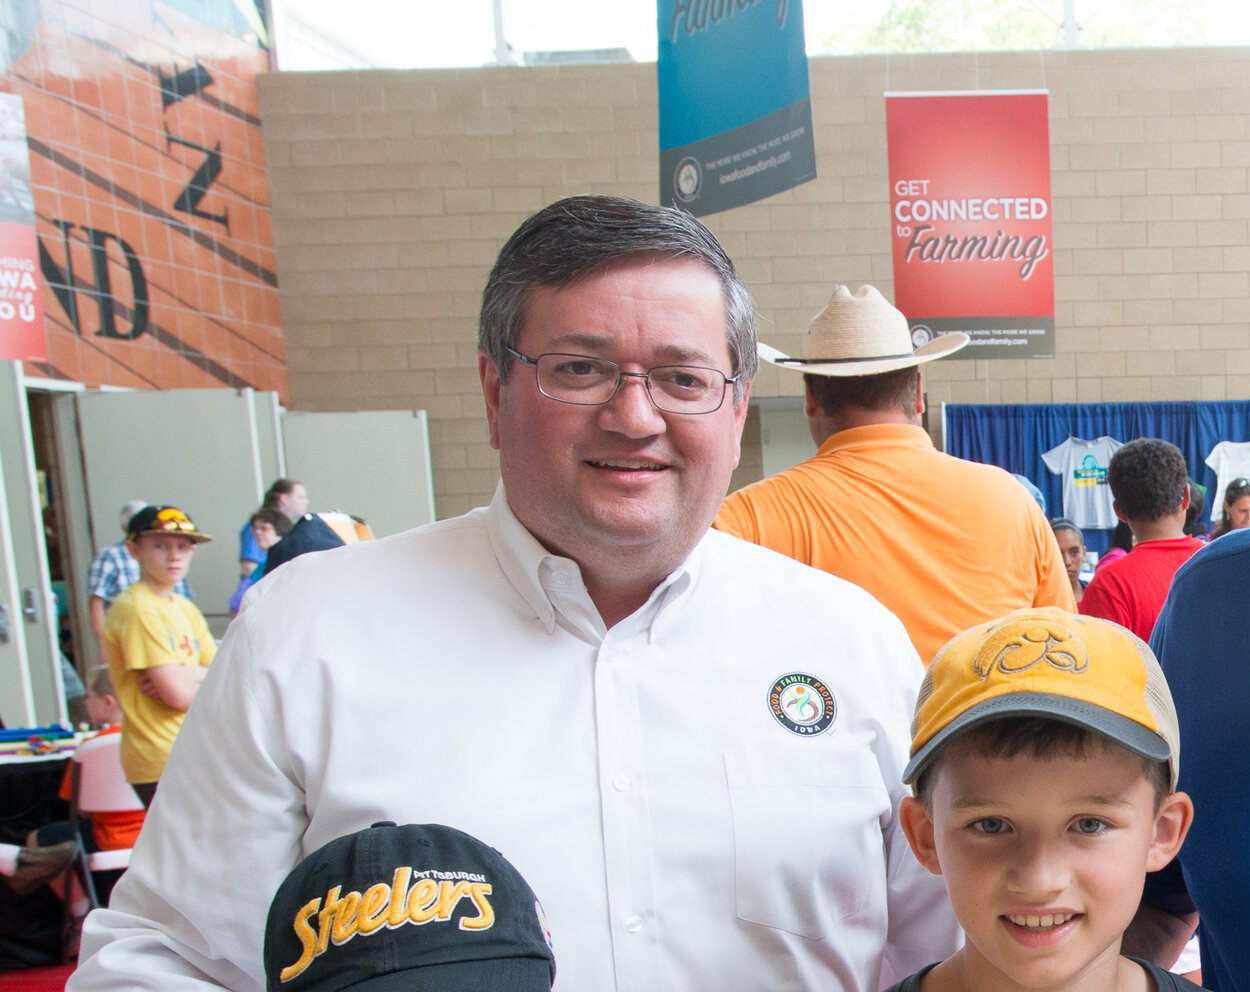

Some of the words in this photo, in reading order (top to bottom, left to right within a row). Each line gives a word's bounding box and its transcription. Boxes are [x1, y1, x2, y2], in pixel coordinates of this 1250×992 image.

[895, 180, 931, 196] GET
[895, 197, 1048, 222] CONNECTED
[896, 224, 912, 237] to
[905, 224, 1049, 281] Farming
[771, 693, 782, 715] FOOD
[780, 675, 812, 686] FAMILY
[413, 869, 487, 883] PITTSBURGH
[280, 866, 496, 983] Steelers
